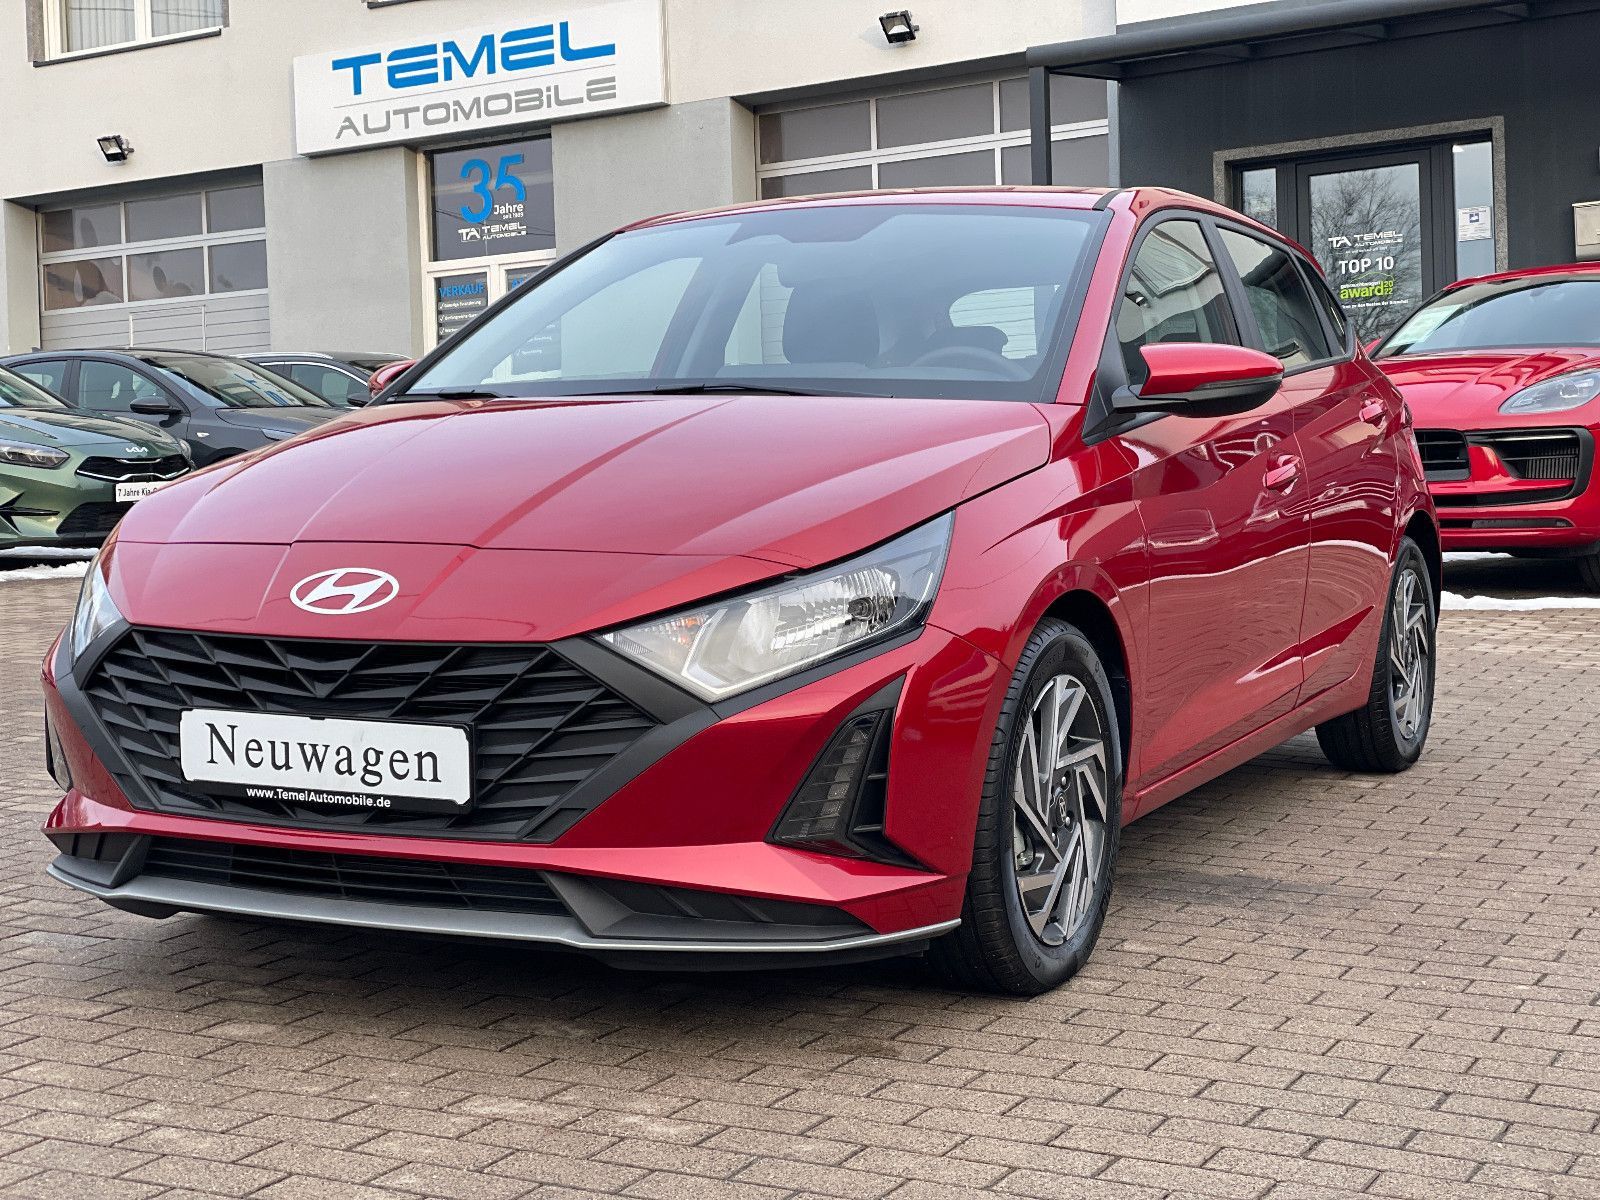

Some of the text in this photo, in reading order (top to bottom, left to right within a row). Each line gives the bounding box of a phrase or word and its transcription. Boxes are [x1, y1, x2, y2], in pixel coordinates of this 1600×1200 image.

[332, 21, 616, 96] TEMEL
[461, 153, 526, 223] 35
[494, 202, 524, 215] Jahre
[482, 222, 526, 233] TEMEL
[1354, 230, 1403, 241] TEMEL
[1339, 255, 1394, 275] TOP 10
[439, 280, 484, 298] VERKAUF
[1340, 280, 1384, 299] award
[117, 488, 122, 497] 7
[123, 488, 140, 497] Jahre
[205, 722, 442, 787] Neuwagen
[246, 787, 391, 808] www.TemelAutomobile.de
